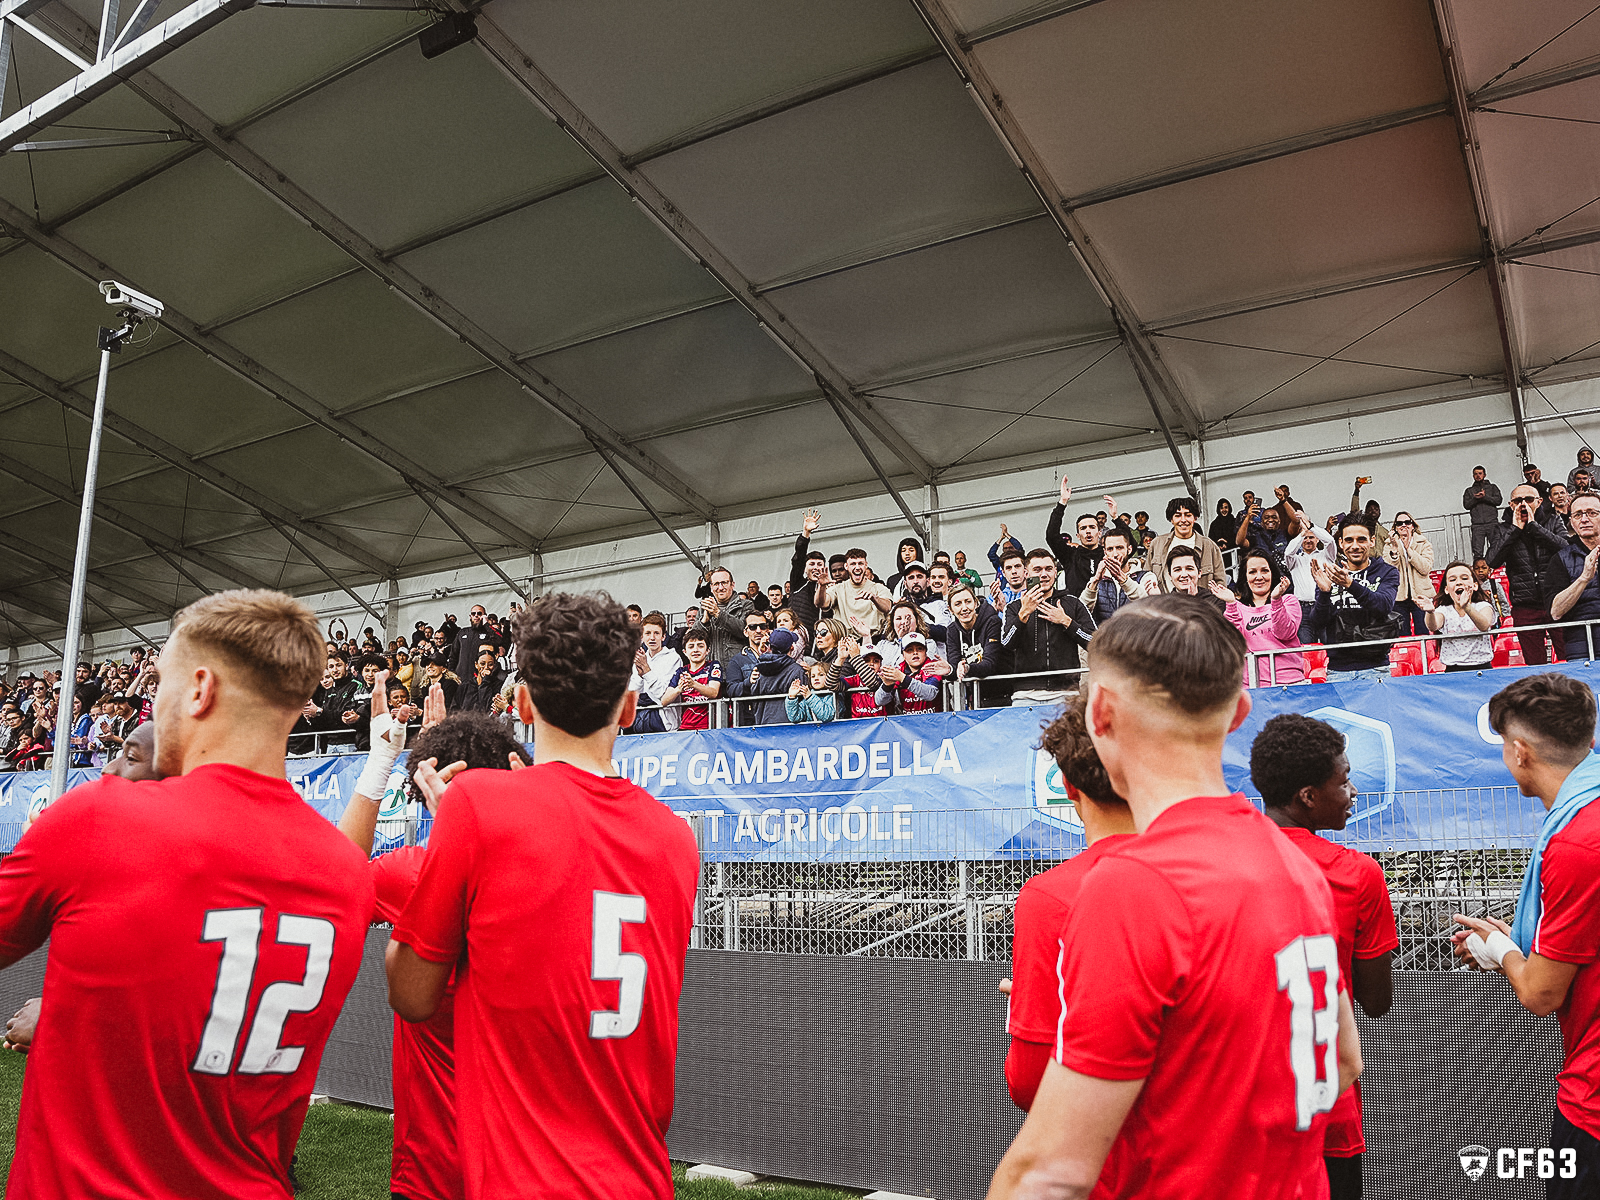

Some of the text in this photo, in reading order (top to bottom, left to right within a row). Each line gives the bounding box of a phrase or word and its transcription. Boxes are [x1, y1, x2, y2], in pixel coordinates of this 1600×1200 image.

[1250, 613, 1269, 624] NIKE
[687, 738, 962, 786] GAMBARDELLA
[733, 803, 914, 844] AGRICOLE
[192, 906, 336, 1076] 12
[589, 890, 648, 1040] 5
[1274, 934, 1340, 1131] 13
